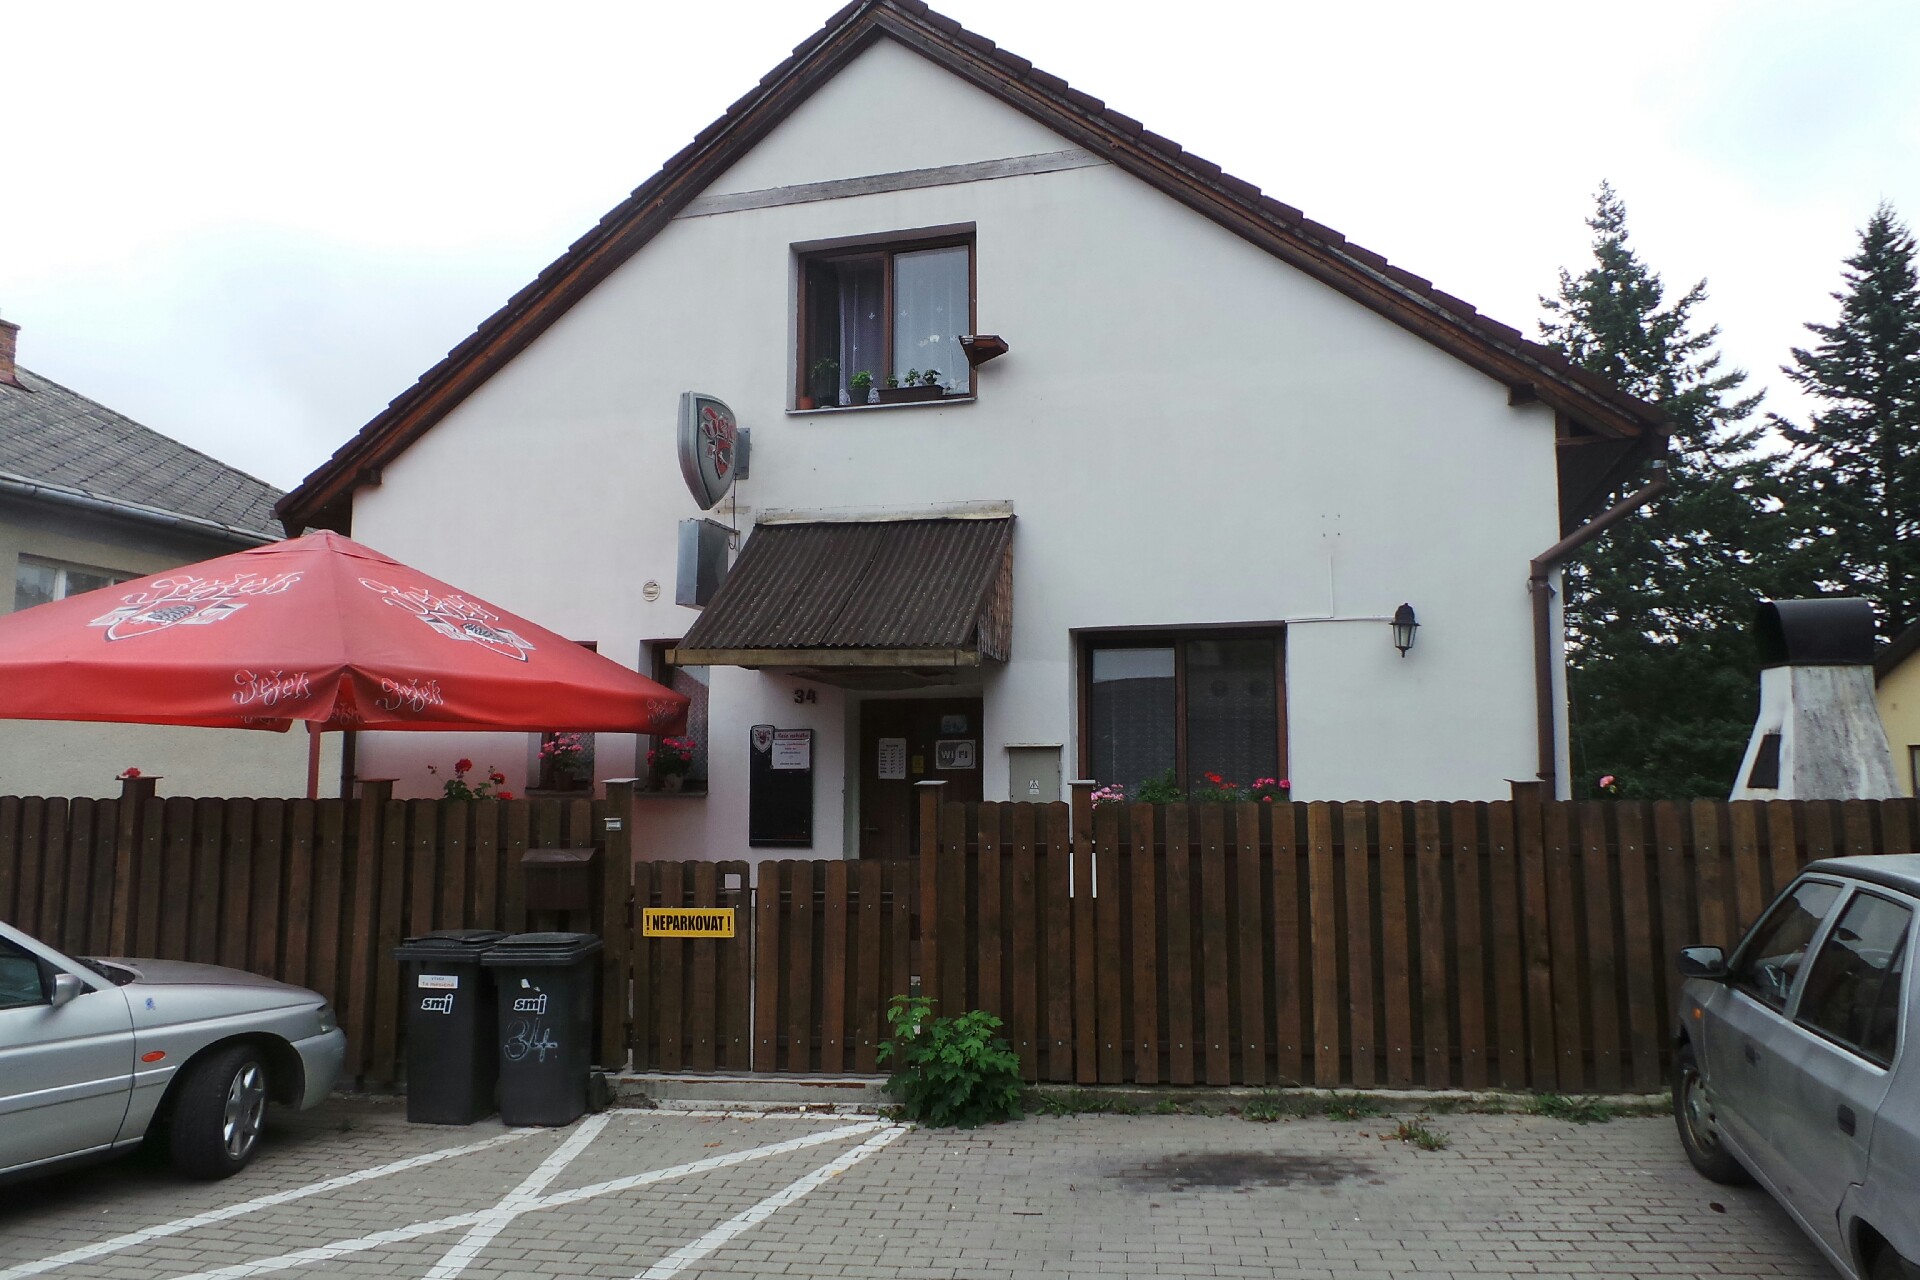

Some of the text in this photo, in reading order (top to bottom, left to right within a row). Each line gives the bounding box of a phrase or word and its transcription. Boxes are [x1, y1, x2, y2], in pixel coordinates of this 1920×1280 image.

[232, 669, 312, 706] Ježek
[375, 676, 444, 712] Ježek
[794, 688, 816, 704] 34
[652, 914, 724, 931] NEPARKOVAT
[421, 993, 453, 1014] smj
[513, 993, 547, 1014] smj
[504, 1018, 558, 1062] 34
